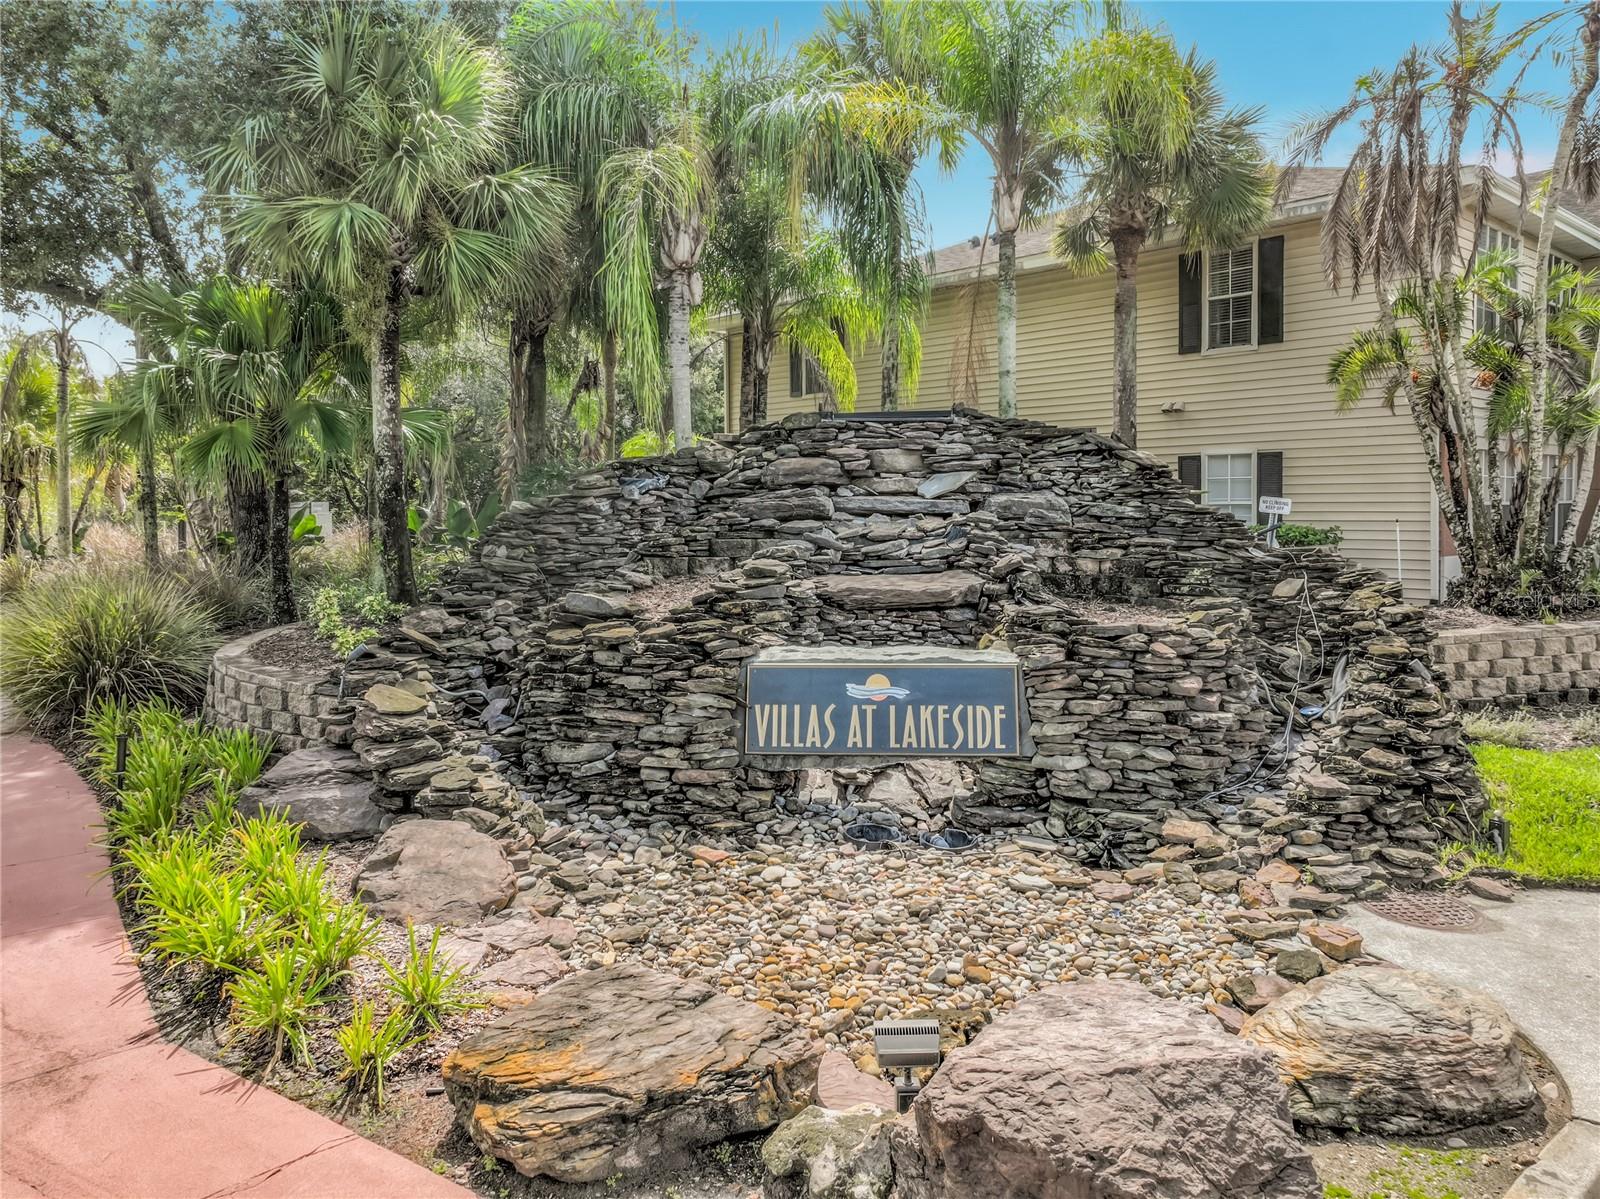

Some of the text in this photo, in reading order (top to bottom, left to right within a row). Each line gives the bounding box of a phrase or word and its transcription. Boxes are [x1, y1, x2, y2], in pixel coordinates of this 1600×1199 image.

[754, 703, 1007, 750] VILLAS AT LAKESIDE
